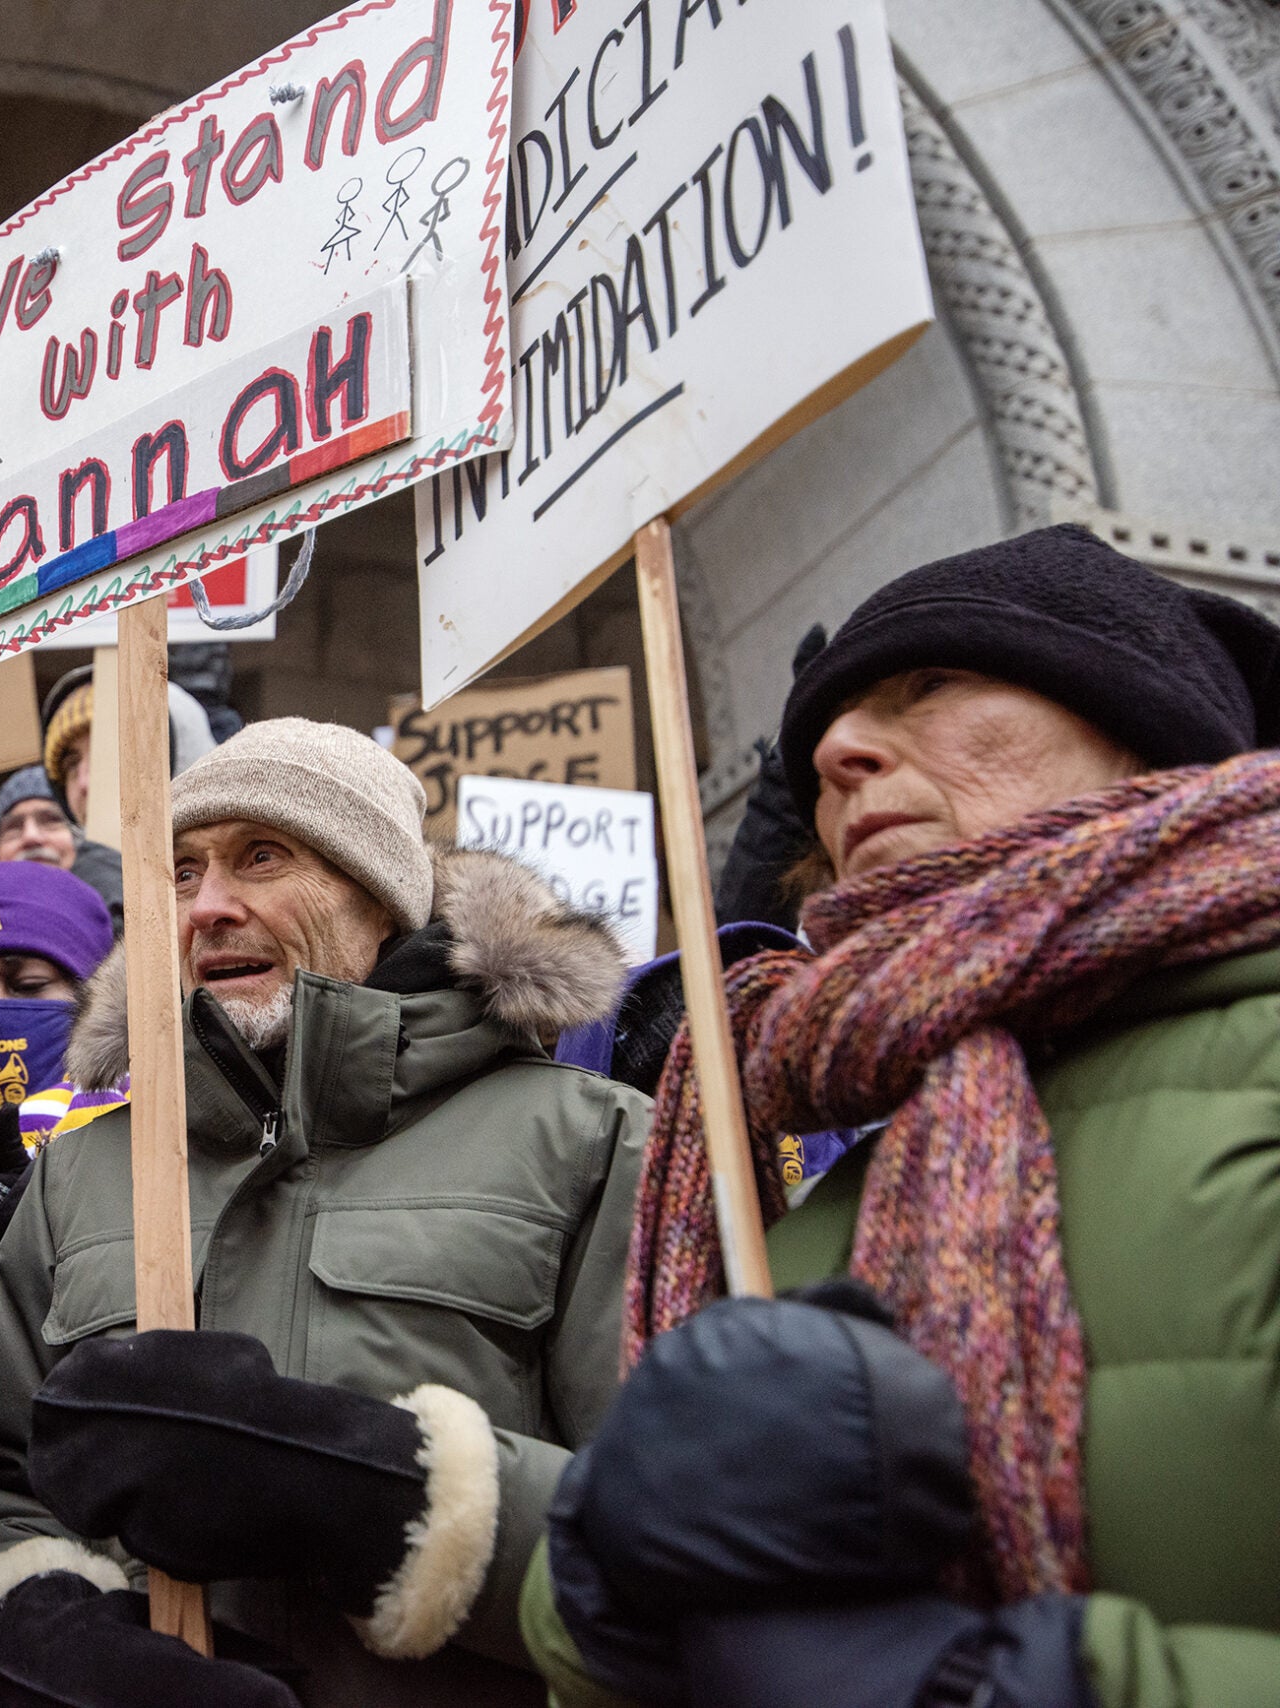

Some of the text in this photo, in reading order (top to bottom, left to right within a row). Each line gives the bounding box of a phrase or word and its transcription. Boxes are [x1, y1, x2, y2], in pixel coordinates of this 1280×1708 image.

[117, 0, 453, 262] Stand
[40, 243, 233, 421] with
[423, 23, 874, 567] INIMIDATION!
[398, 695, 619, 765] SUPPORT
[465, 795, 642, 856] SUPPORT
